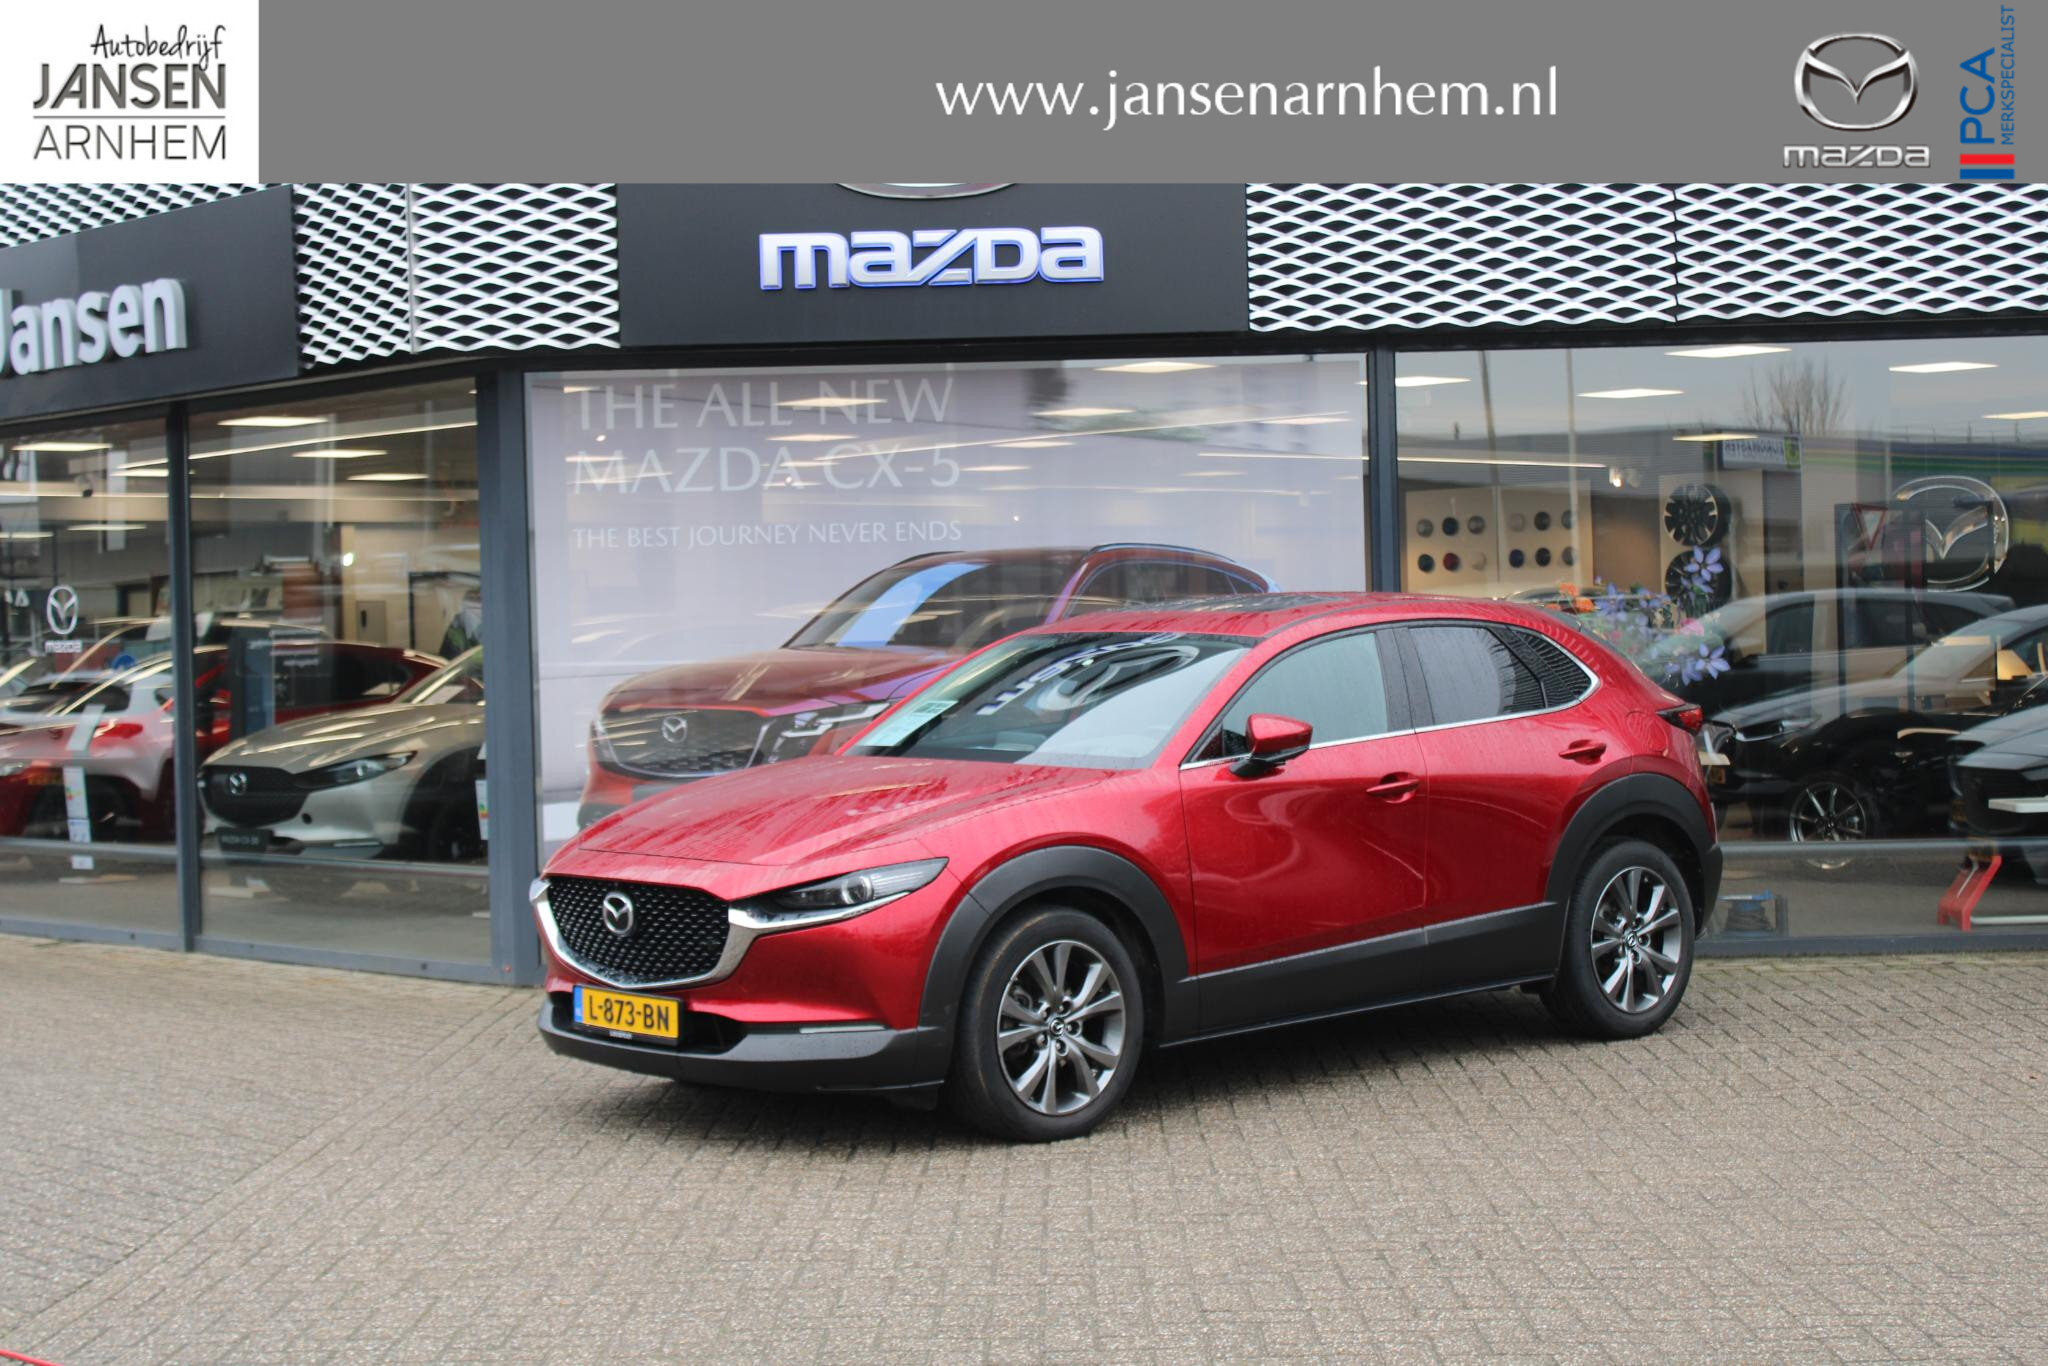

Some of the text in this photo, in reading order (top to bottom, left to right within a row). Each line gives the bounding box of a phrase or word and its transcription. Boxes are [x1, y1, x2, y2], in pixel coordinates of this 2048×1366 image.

[573, 377, 953, 431] THE ALL NEW
[574, 442, 961, 496] MAZDA CX-5
[573, 519, 962, 550] THE BEST JOURNEY NEVER ENDS
[589, 995, 669, 1032] L-873-BN
